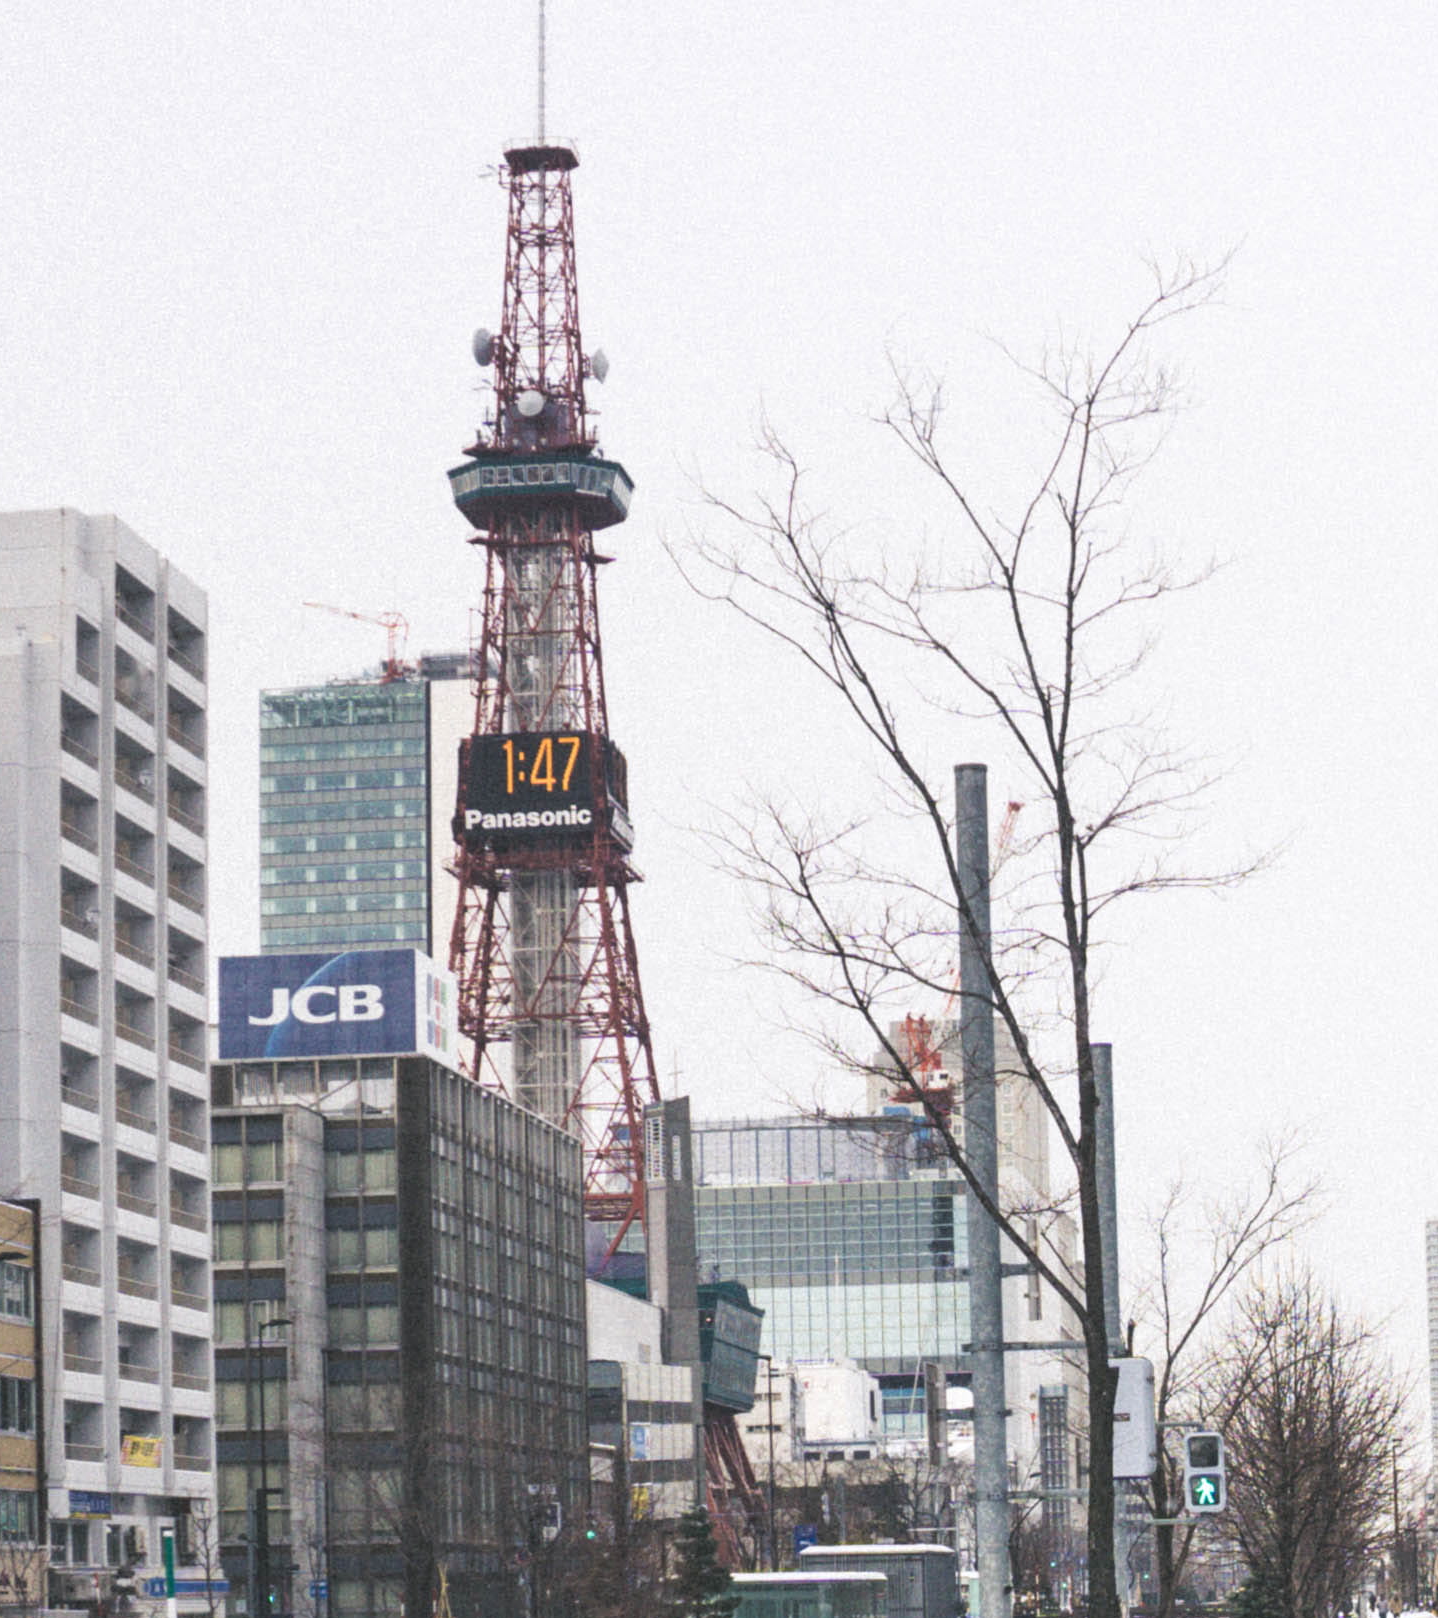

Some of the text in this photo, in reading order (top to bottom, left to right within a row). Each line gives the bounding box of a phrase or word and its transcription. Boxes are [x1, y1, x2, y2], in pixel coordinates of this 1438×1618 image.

[503, 736, 581, 794] 1:47
[464, 804, 593, 830] Panasonic
[248, 984, 386, 1026] JCB
